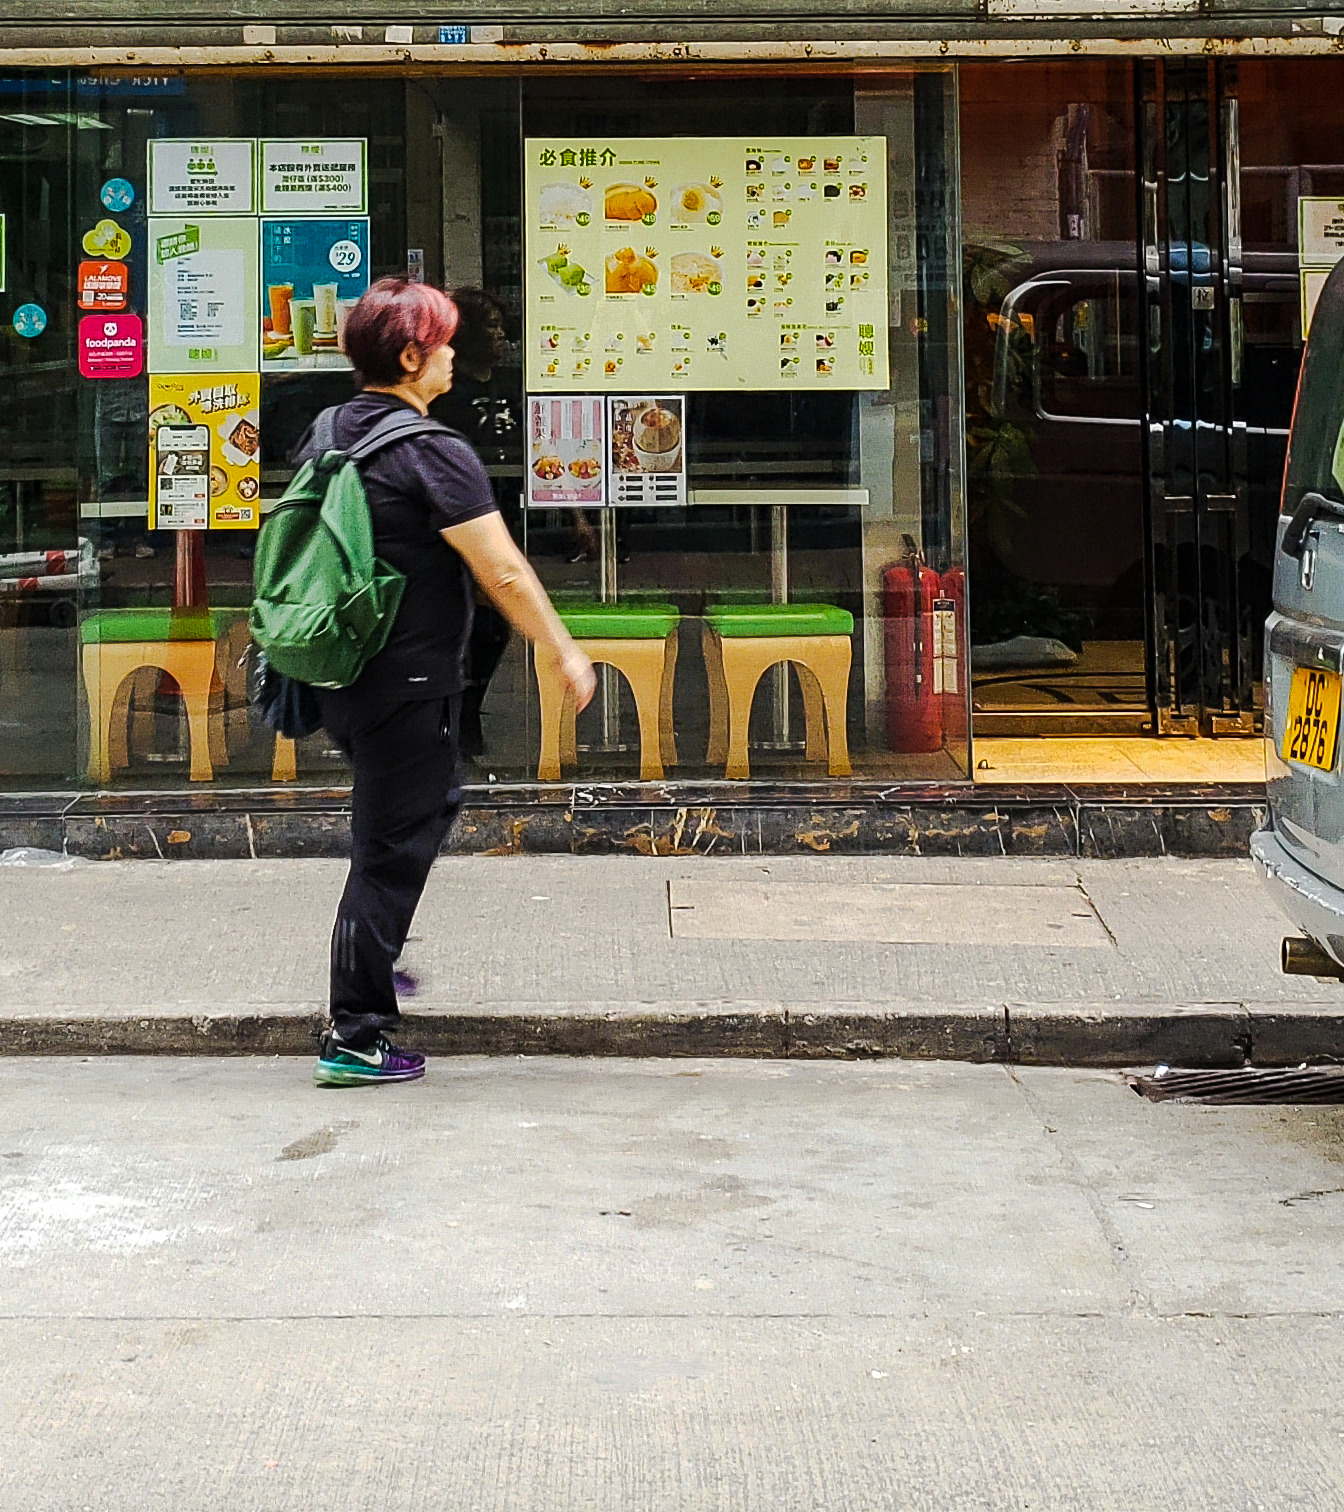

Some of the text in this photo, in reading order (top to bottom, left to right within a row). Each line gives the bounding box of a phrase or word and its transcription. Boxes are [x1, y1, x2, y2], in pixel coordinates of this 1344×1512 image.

[539, 148, 617, 167] 必食推介
[85, 336, 137, 350] foodpanda
[1306, 673, 1325, 718] DC
[1289, 714, 1328, 765] 2876
